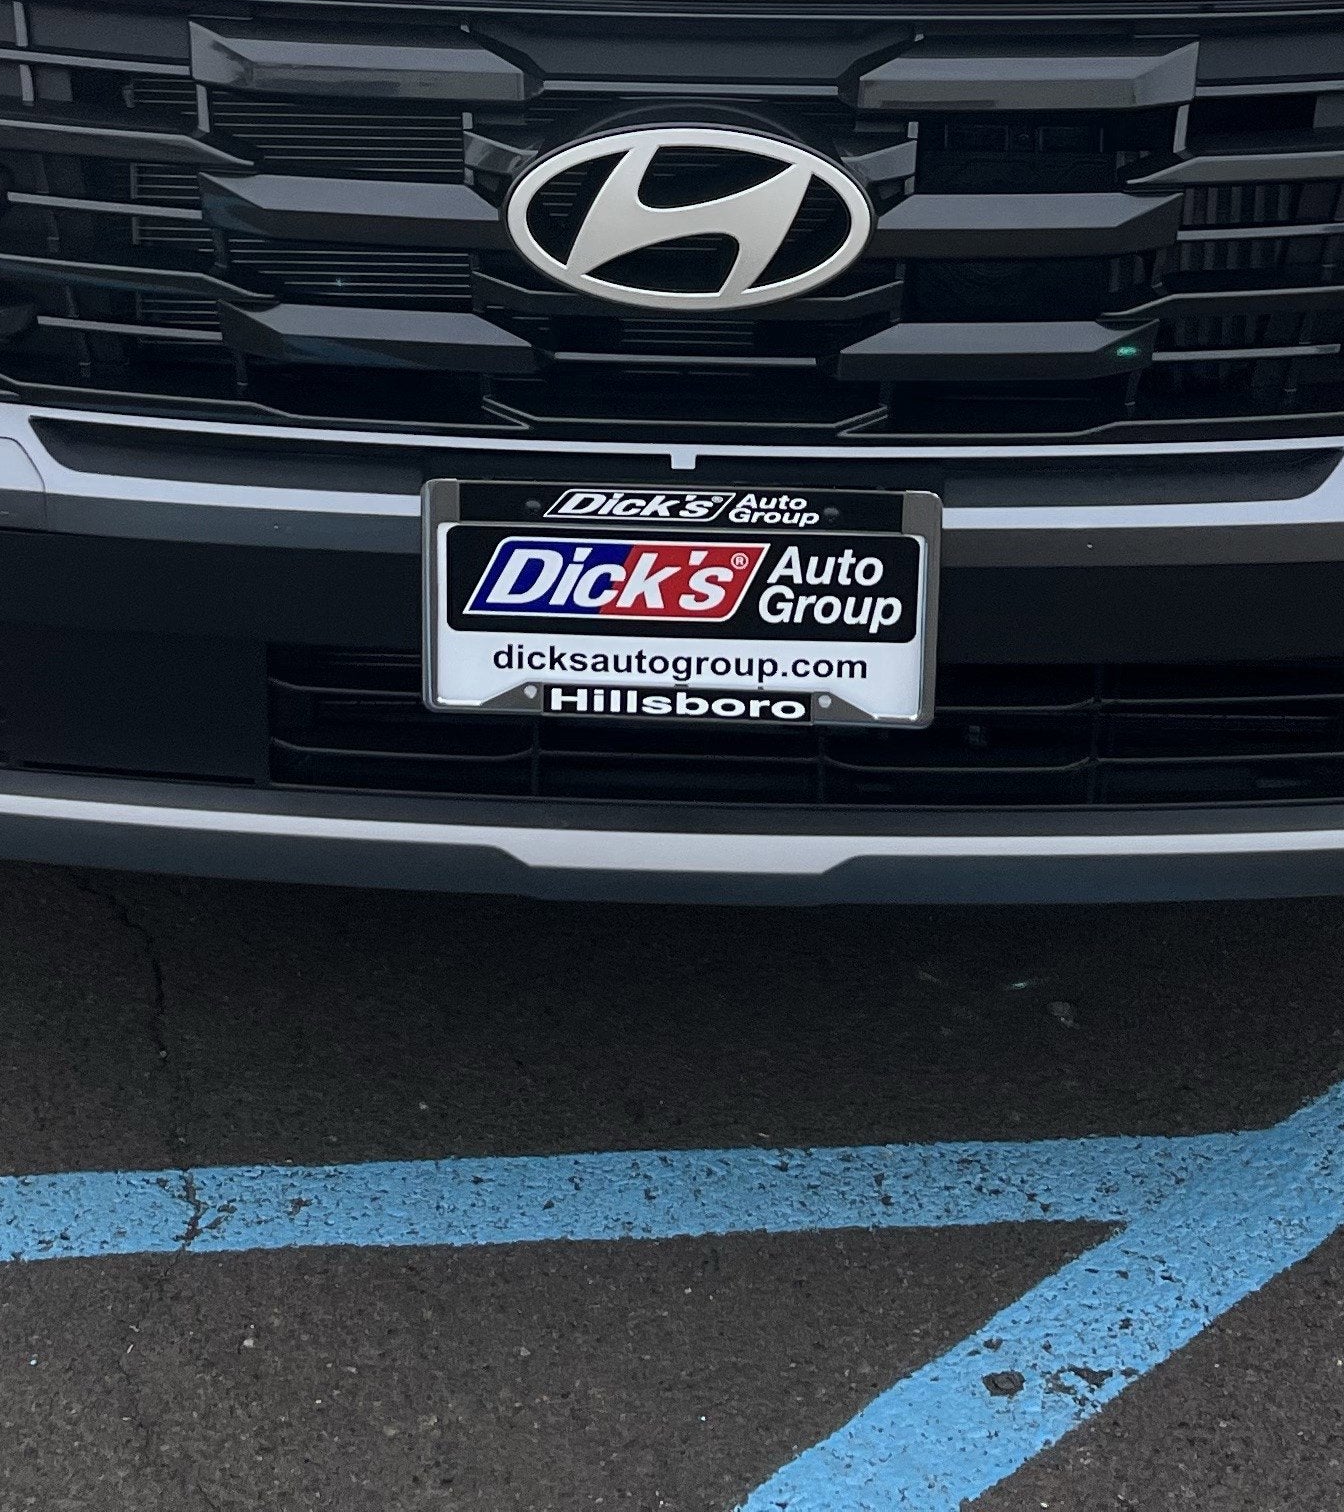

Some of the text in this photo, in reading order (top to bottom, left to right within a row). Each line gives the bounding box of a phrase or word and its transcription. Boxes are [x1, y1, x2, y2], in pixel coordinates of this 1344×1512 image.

[728, 507, 820, 527] Group
[735, 494, 807, 511] Auto
[767, 546, 885, 587] Auto
[758, 585, 903, 634] Group
[493, 644, 869, 682] dicksautogroup.com
[550, 687, 807, 720] Hillsboro
